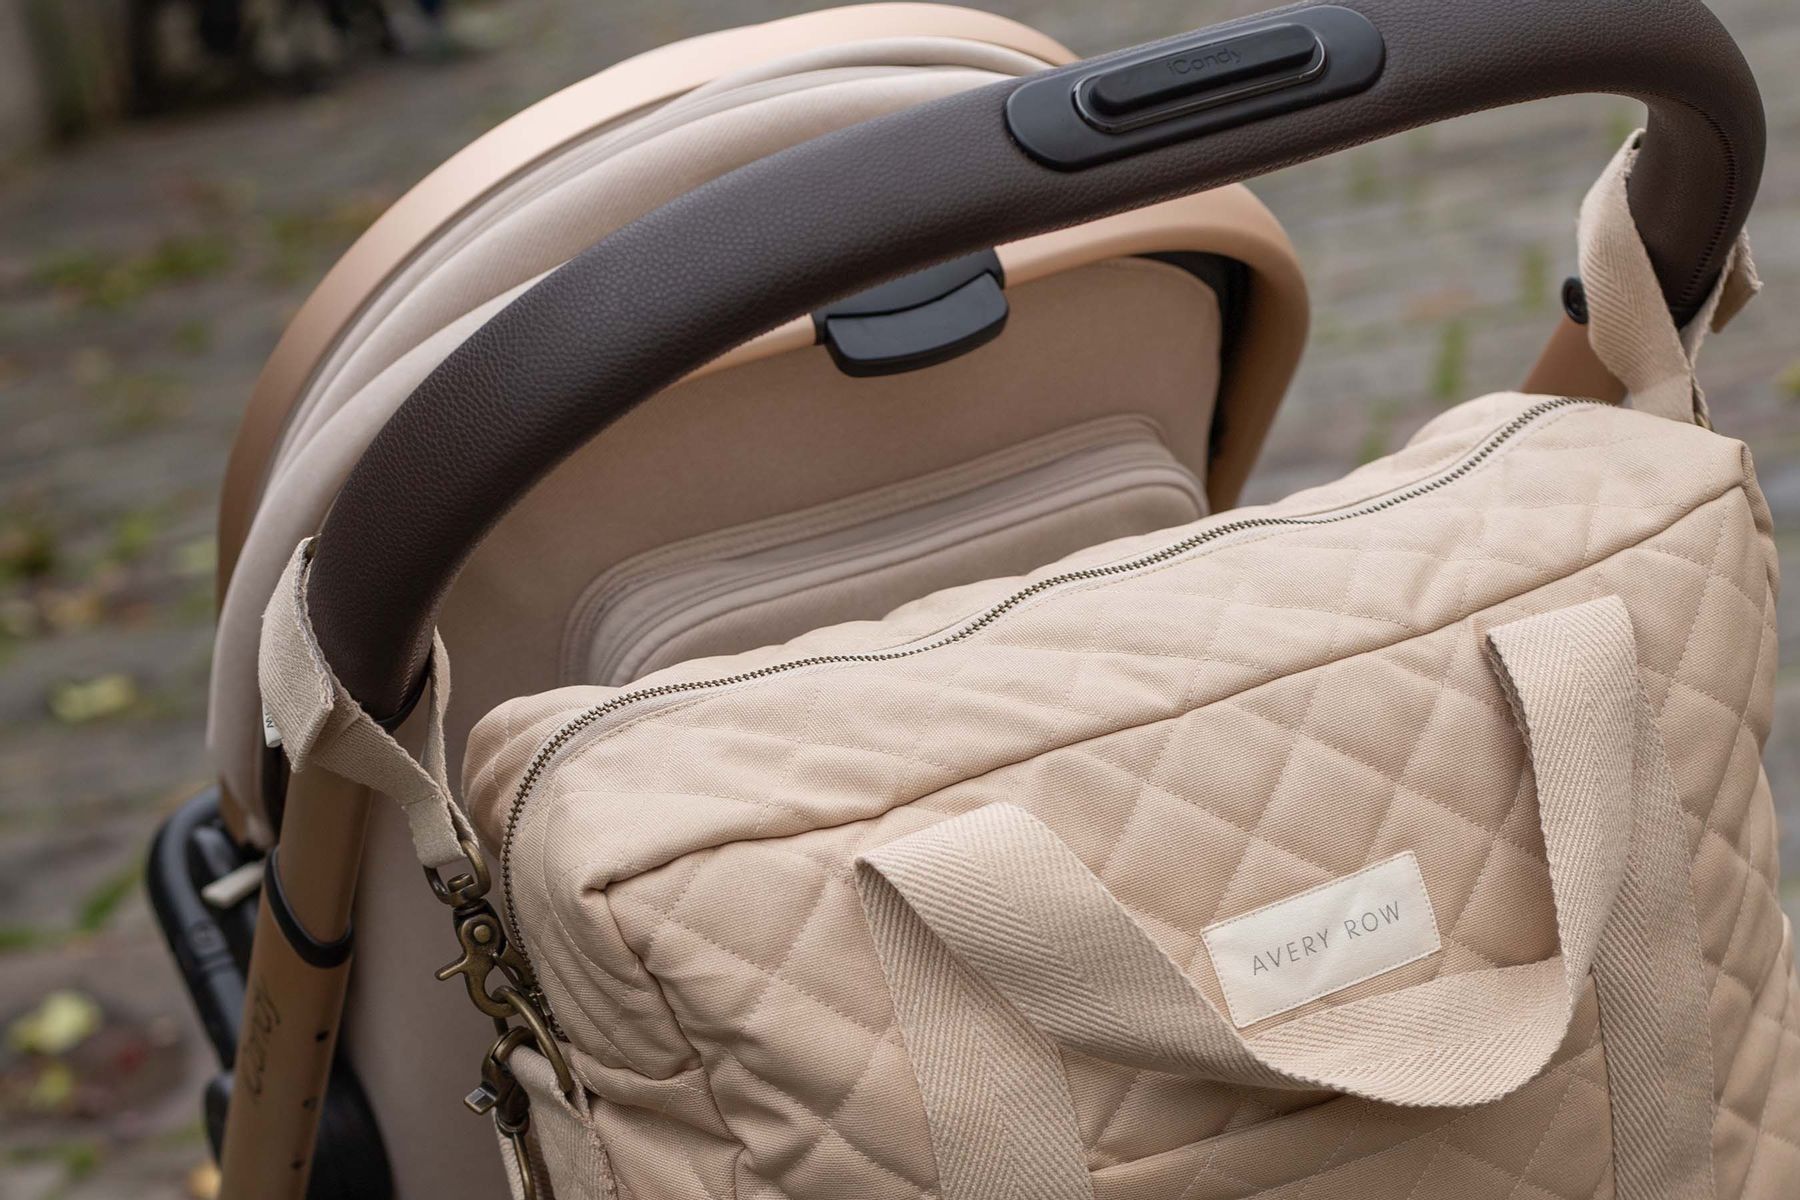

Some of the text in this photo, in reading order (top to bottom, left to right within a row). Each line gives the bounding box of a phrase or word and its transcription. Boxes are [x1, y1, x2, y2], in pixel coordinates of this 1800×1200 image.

[1166, 47, 1243, 76] iCandy
[1253, 901, 1400, 976] AVERY ROW
